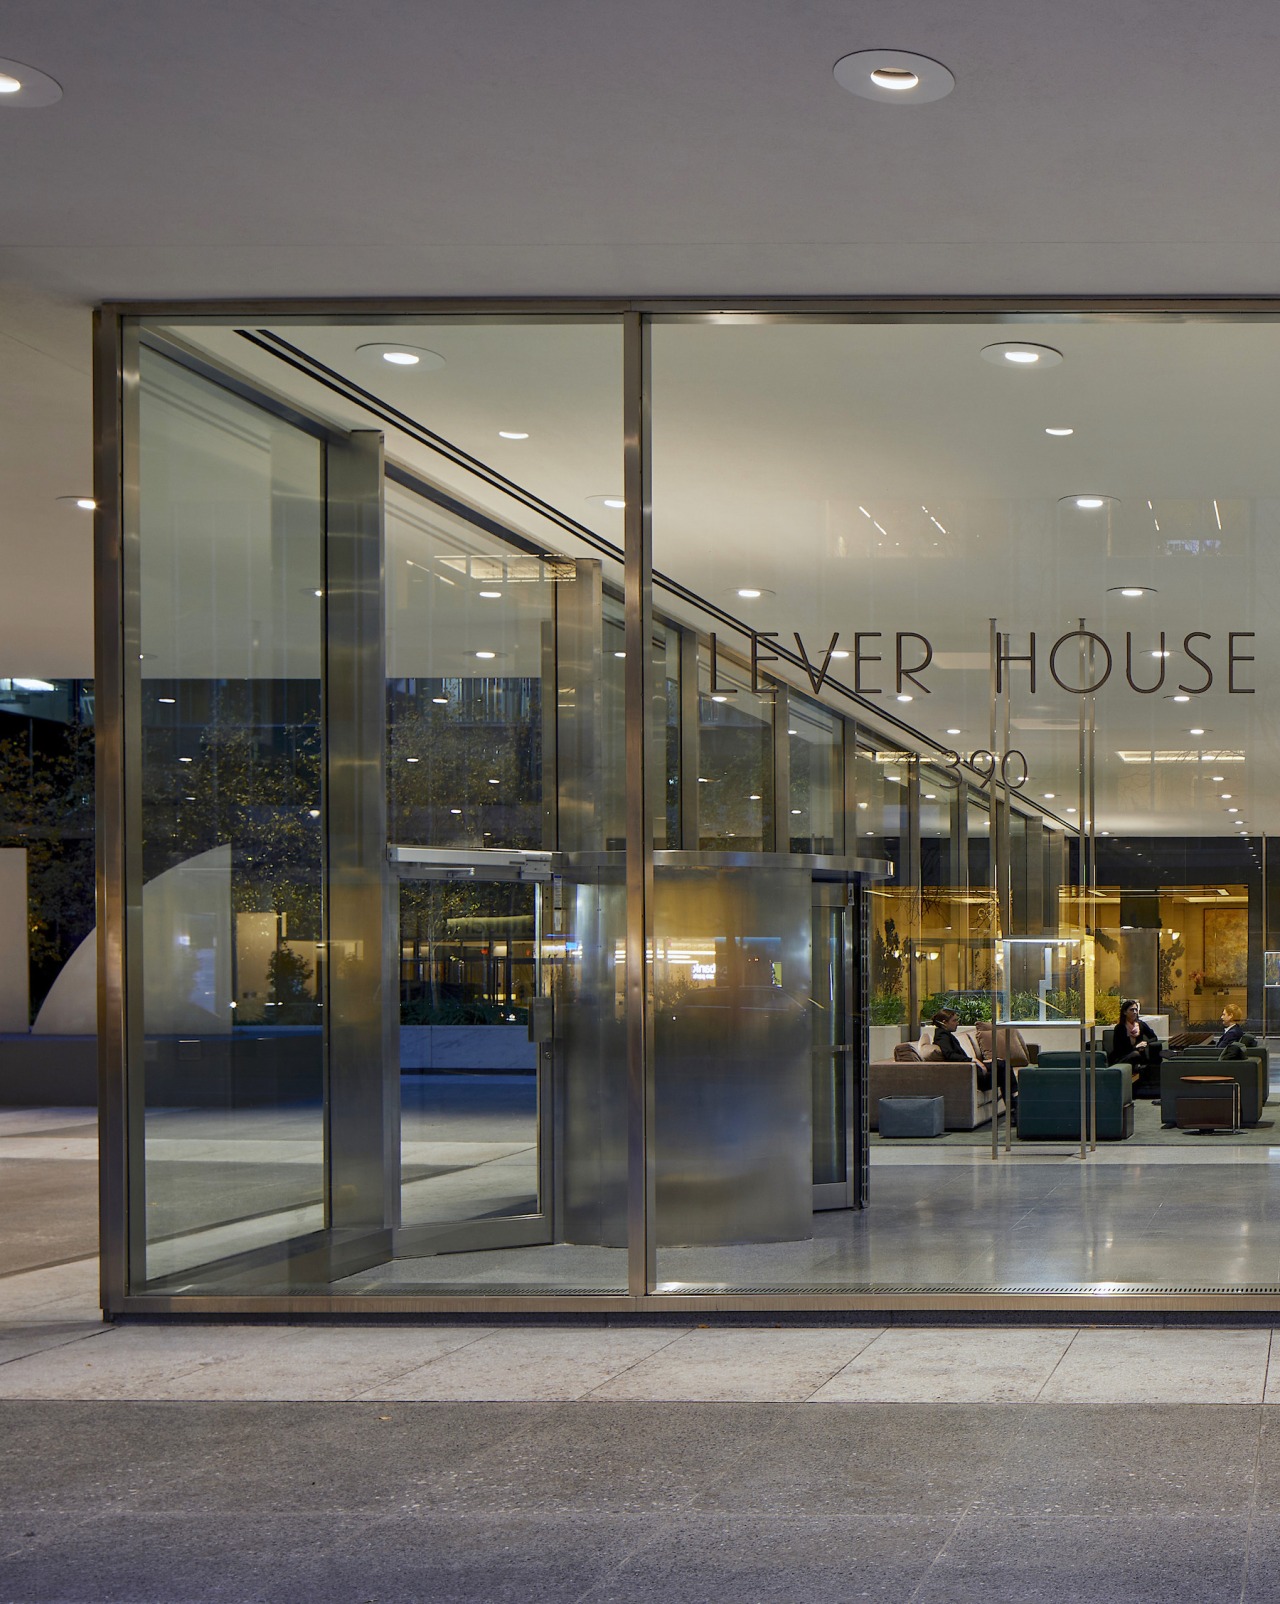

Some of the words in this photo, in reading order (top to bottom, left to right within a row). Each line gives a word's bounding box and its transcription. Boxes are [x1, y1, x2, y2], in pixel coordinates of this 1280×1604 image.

[709, 632, 933, 694] LEVER
[996, 631, 1256, 694] HOUSE
[939, 749, 1028, 789] 390
